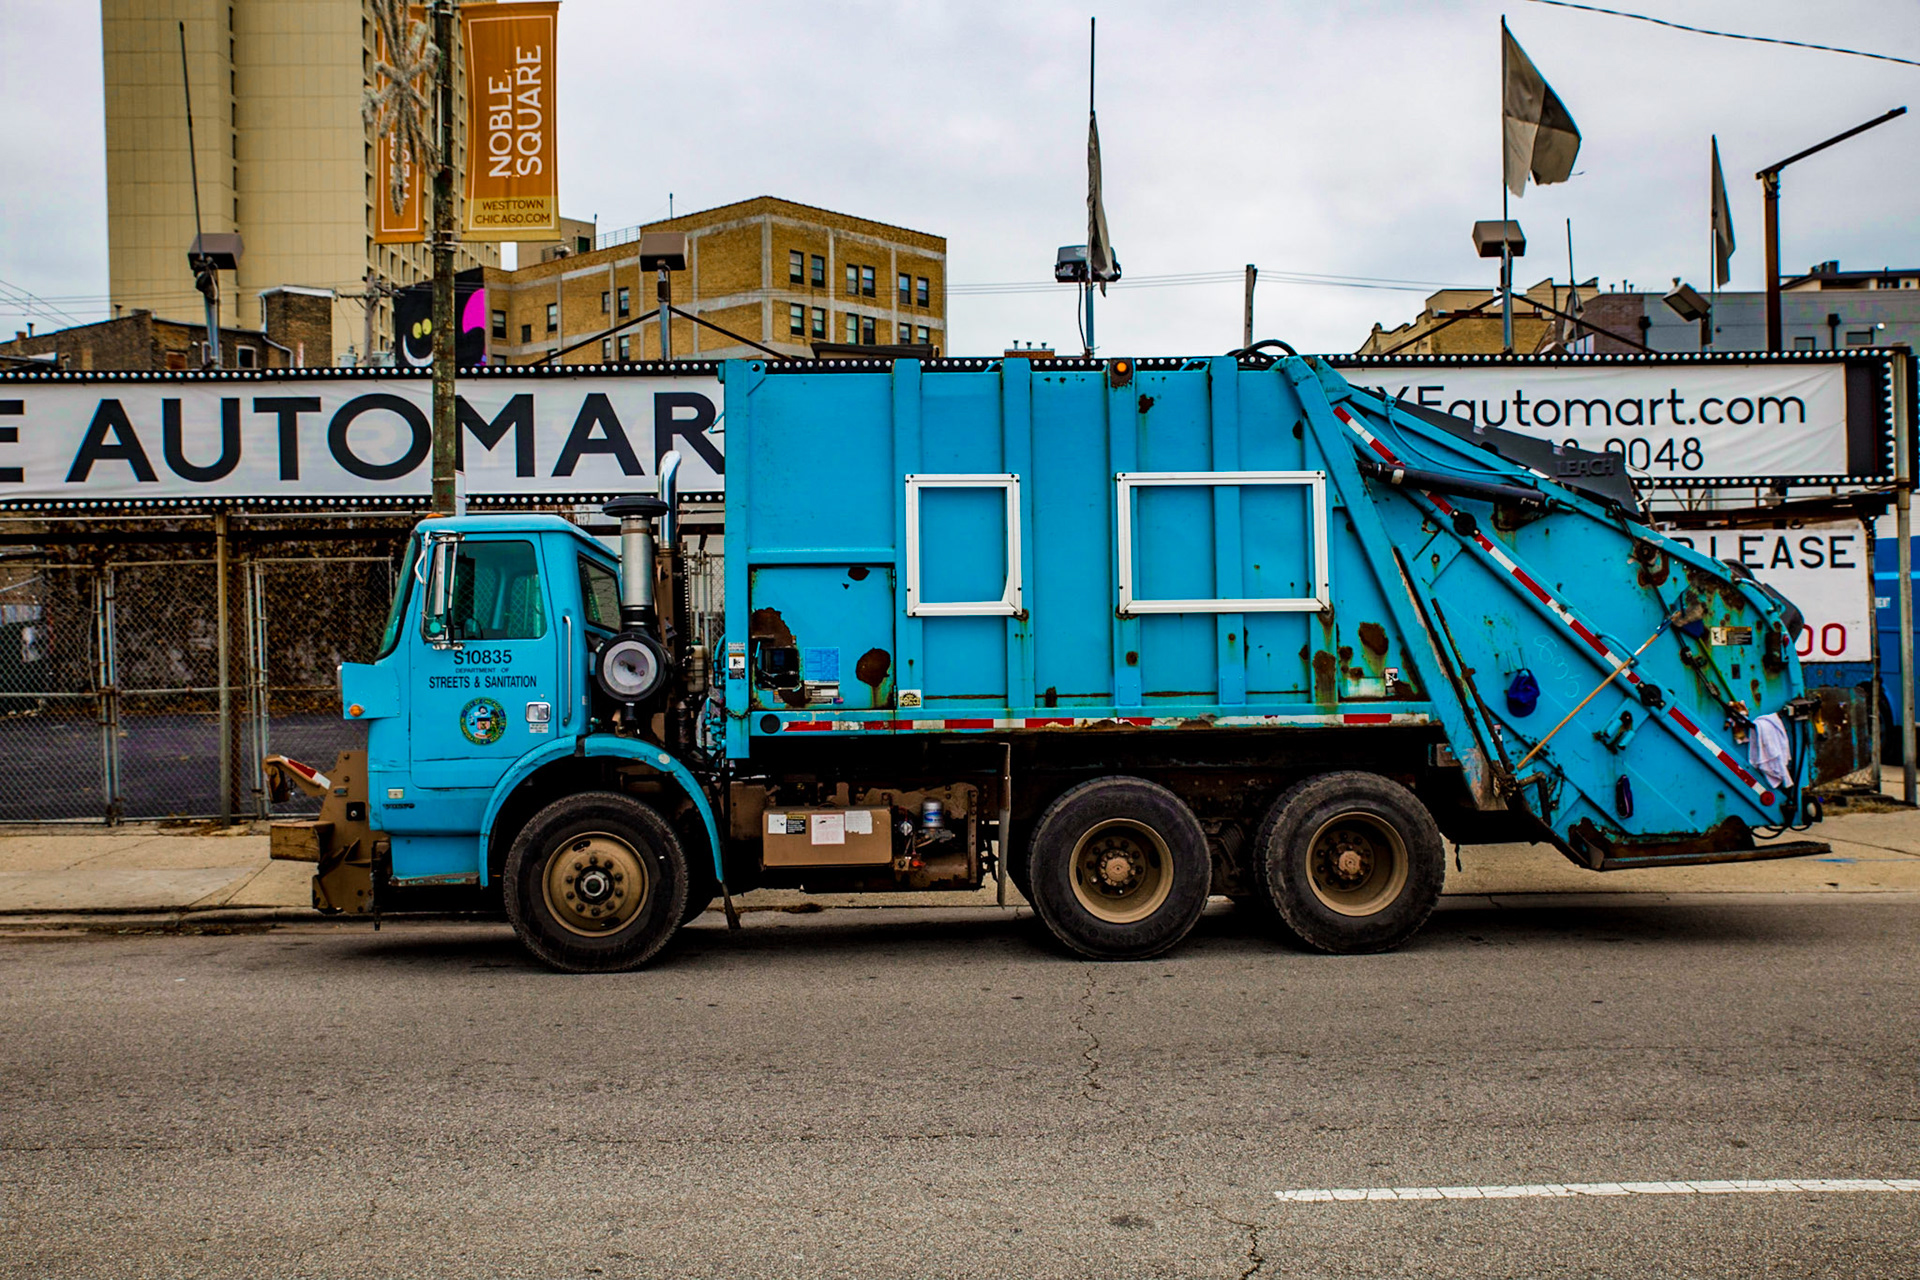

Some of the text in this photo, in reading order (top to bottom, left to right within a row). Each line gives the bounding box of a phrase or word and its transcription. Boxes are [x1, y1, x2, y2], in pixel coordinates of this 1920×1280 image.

[516, 45, 542, 176] SQUARE
[488, 75, 512, 178] NOBLE
[482, 199, 544, 211] WESTTOWN
[475, 213, 550, 224] CHICAGO.COM
[1363, 386, 1805, 425] Eautomart.com
[65, 392, 724, 482] AUTOMAR
[1554, 458, 1615, 477] LEACH
[454, 649, 512, 665] S10835
[429, 675, 537, 688] STREETS & SANITATION
